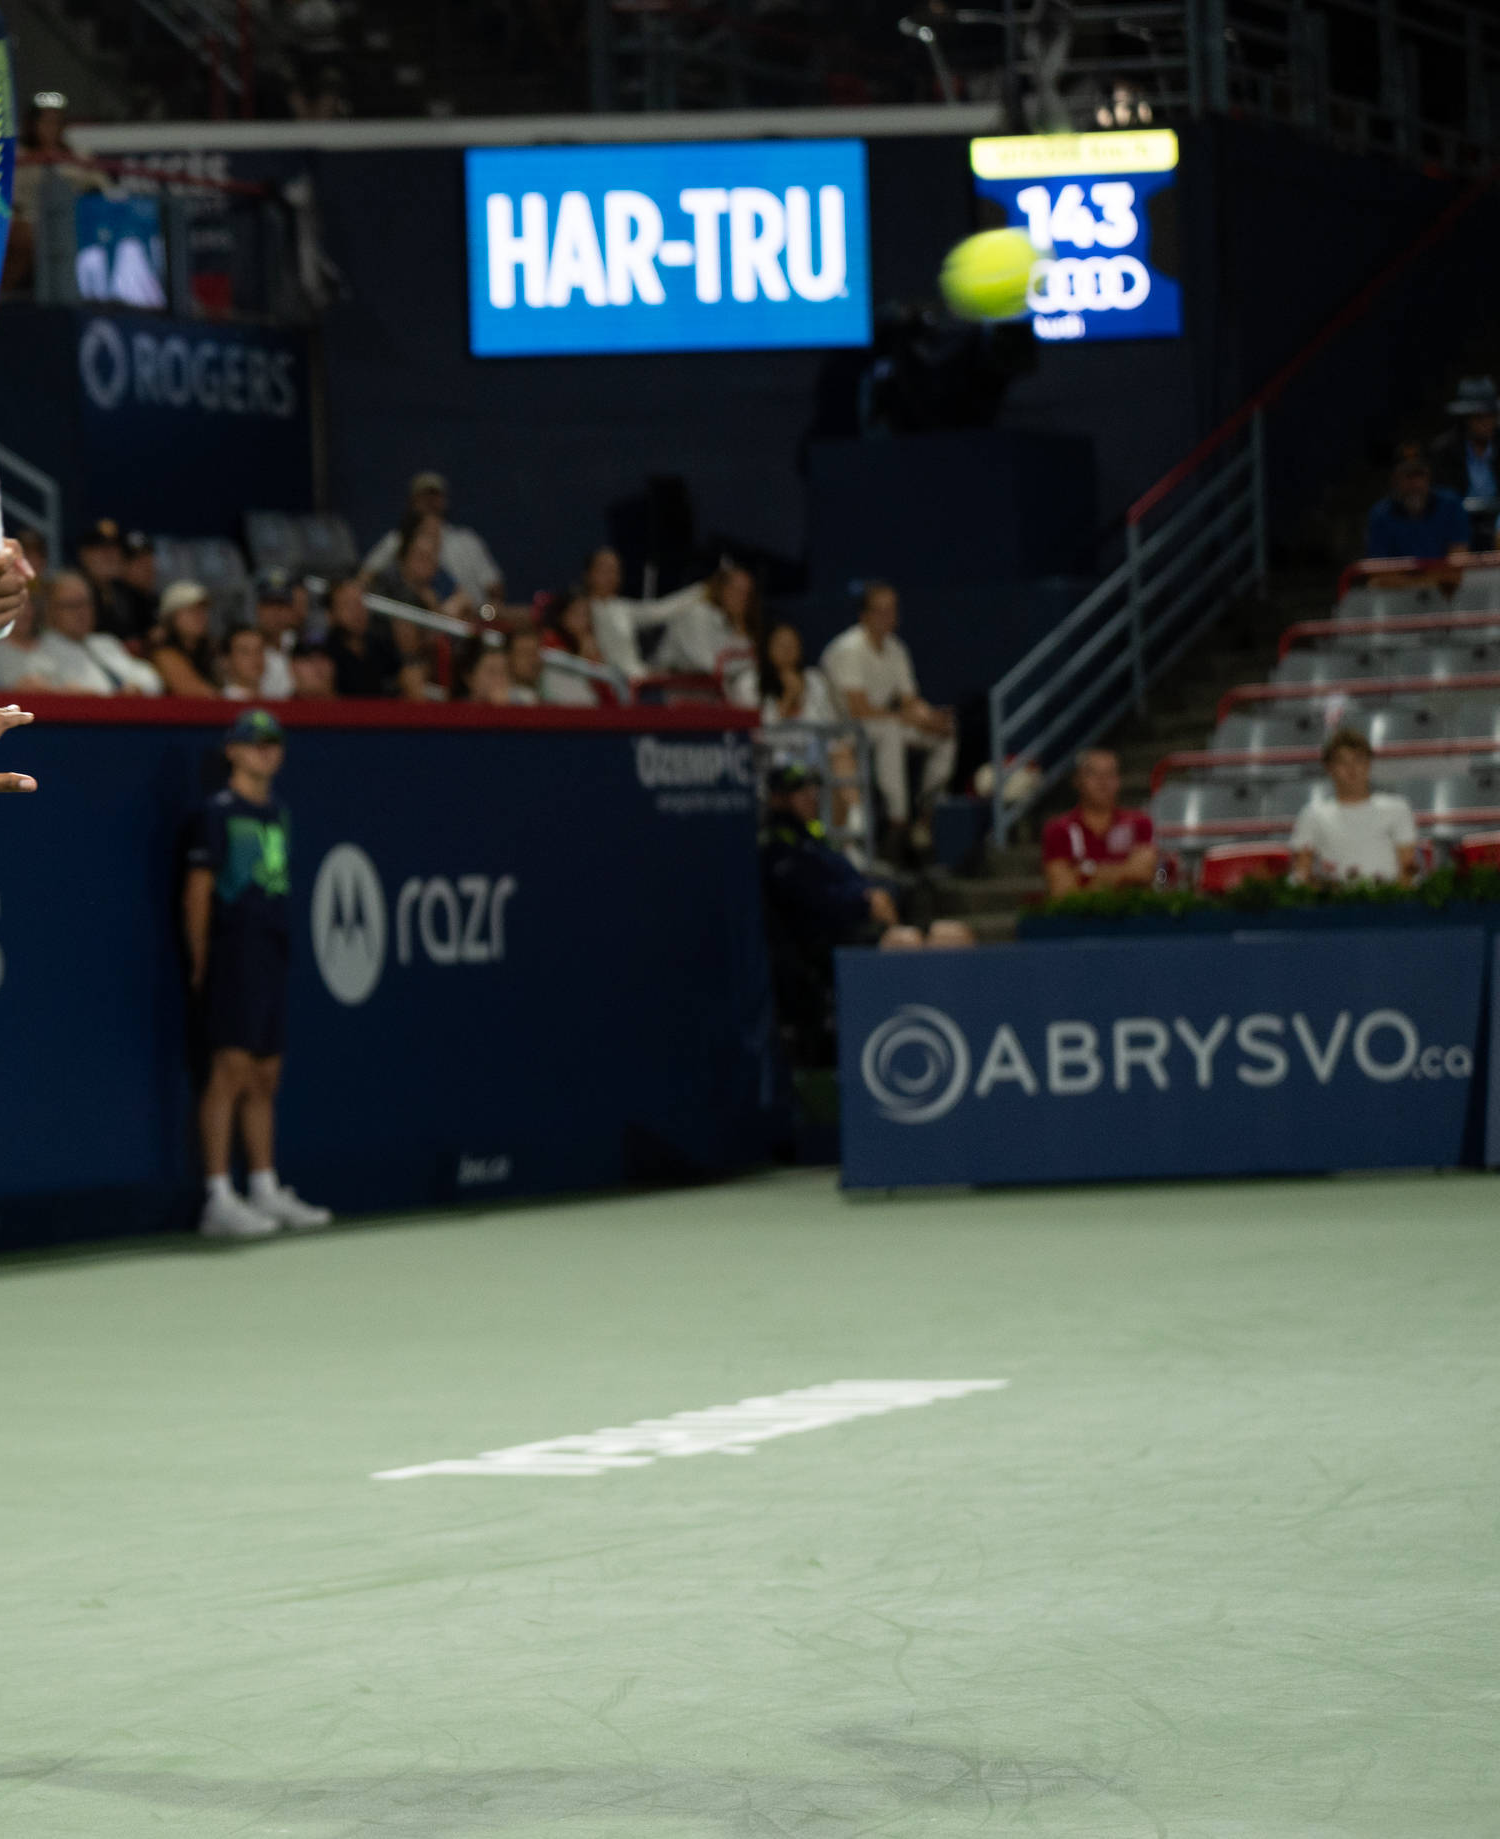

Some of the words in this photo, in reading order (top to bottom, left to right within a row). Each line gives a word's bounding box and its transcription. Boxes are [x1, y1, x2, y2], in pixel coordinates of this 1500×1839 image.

[486, 184, 847, 310] HAR-TRU
[1016, 181, 1139, 251] 143
[132, 332, 296, 419] ROGERS
[396, 874, 518, 967] razr
